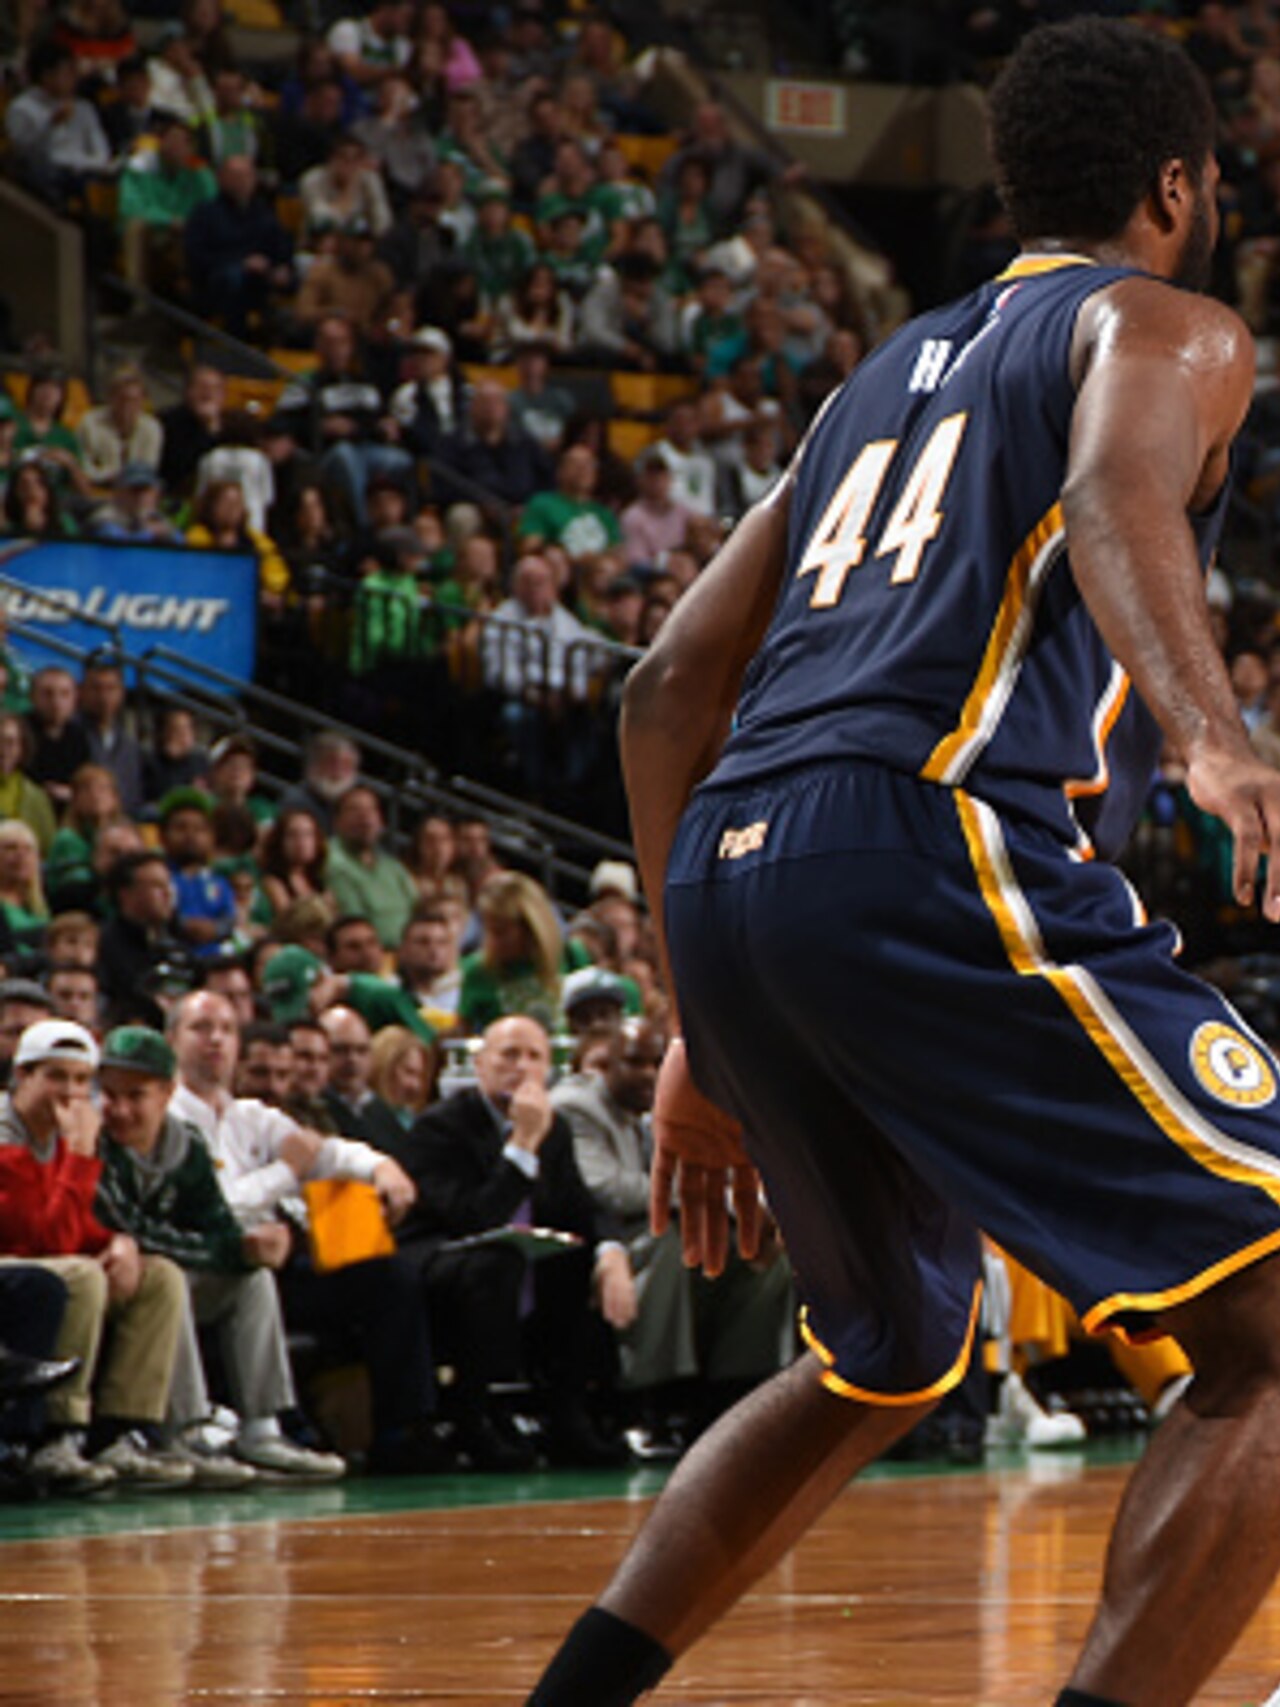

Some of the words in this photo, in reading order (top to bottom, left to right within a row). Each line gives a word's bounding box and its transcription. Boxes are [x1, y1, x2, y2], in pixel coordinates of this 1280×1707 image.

[797, 409, 968, 609] 44
[0, 586, 79, 622] UD
[82, 586, 229, 631] LIGHT
